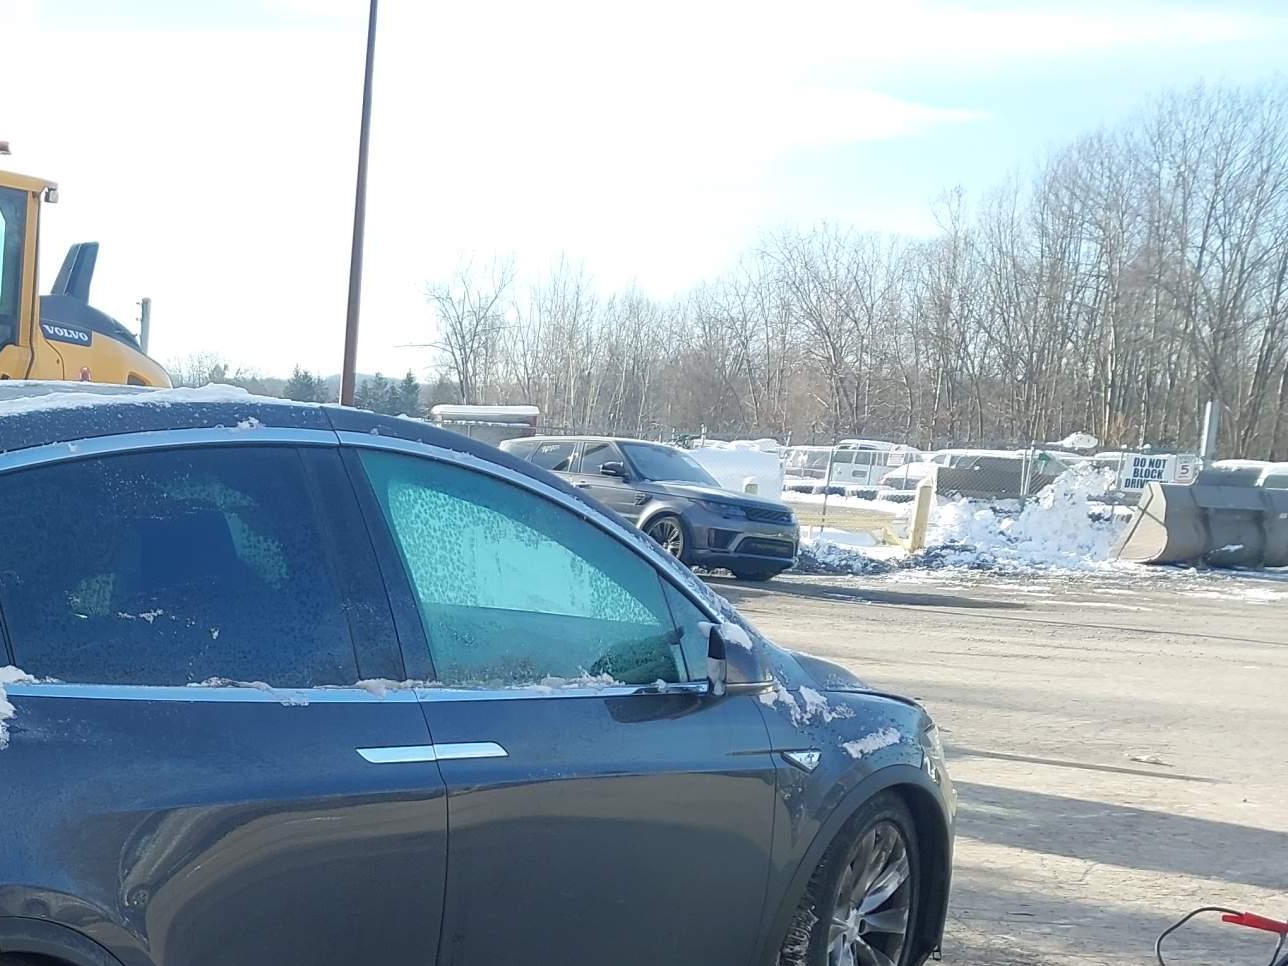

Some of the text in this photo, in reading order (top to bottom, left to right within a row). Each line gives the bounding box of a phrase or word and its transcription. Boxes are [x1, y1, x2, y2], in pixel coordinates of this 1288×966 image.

[42, 324, 89, 341] VOLVO
[1133, 457, 1147, 467] DO
[1148, 458, 1168, 469] NOT
[1133, 467, 1164, 479] BLOCK
[1180, 464, 1190, 475] 5
